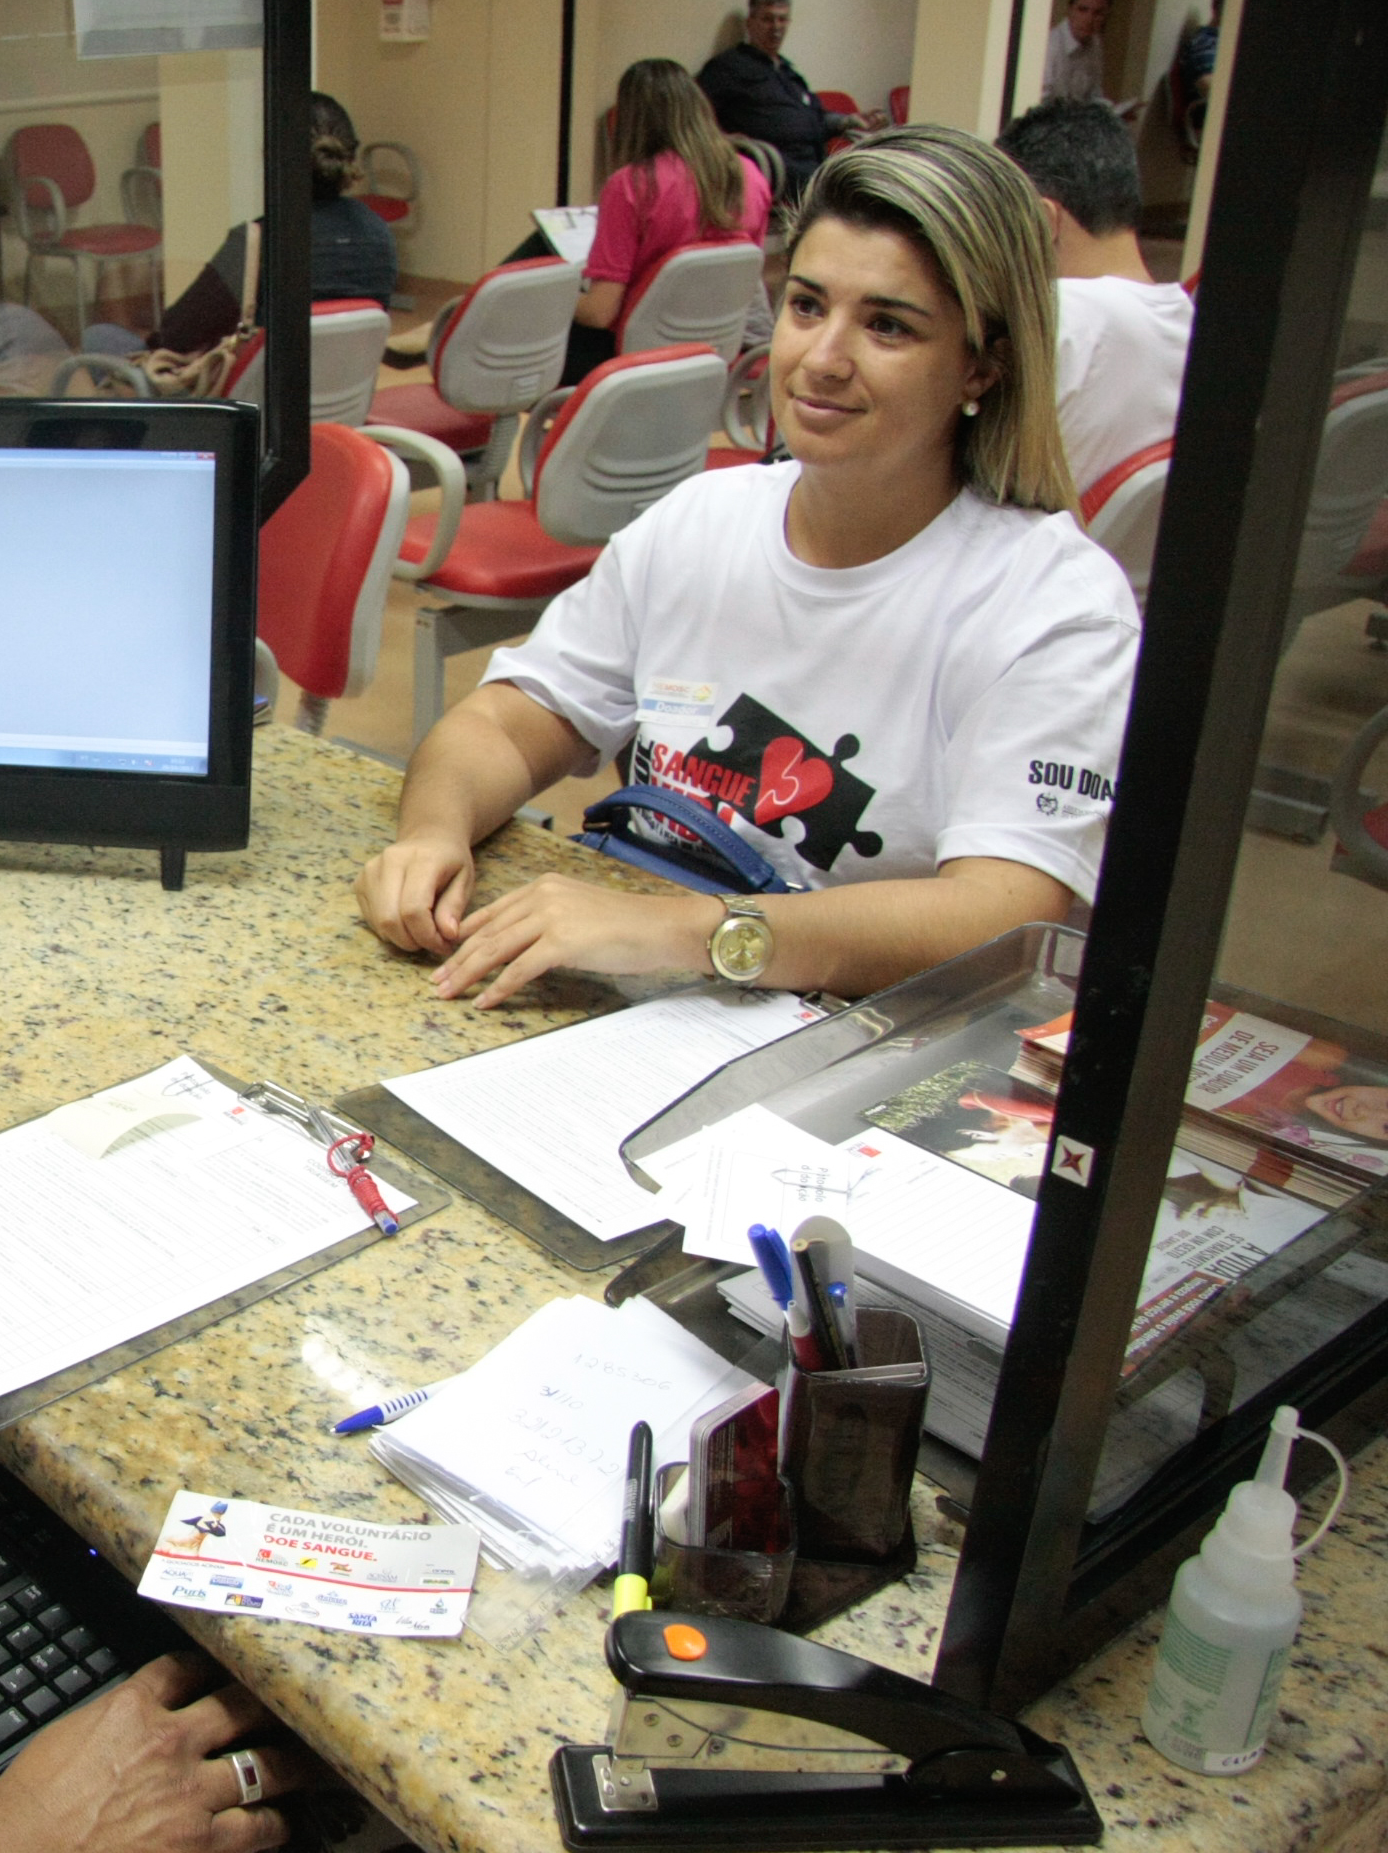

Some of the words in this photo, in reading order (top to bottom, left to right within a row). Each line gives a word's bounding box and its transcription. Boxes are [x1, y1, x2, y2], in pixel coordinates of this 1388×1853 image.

[655, 701, 699, 716] Doador
[650, 742, 759, 808] SANGUE
[1028, 760, 1074, 790] SOU
[1077, 768, 1116, 801] DOA
[1228, 1029, 1256, 1046] DE
[1195, 1041, 1243, 1077] MEDULA
[1244, 1041, 1280, 1062] SEJA
[1229, 1058, 1260, 1074] UM
[1196, 1070, 1244, 1095] DOADOR
[1191, 1233, 1207, 1246] UM
[1201, 1225, 1225, 1240] COM
[1225, 1233, 1245, 1245] SE
[1180, 1243, 1236, 1270] TRANSMITE
[1244, 1243, 1270, 1256] A
[1204, 1252, 1262, 1281] VIDA
[573, 1353, 672, 1391] 1285306
[266, 1523, 276, 1533] É
[279, 1526, 307, 1538] UM
[311, 1530, 368, 1549] HERÓI.
[270, 1513, 317, 1528] CADA
[321, 1521, 432, 1542] VOLUNTÁRIO
[263, 1534, 299, 1549] DOE
[302, 1541, 378, 1562] SANGUE.
[347, 1612, 378, 1622] SANTA
[351, 1618, 373, 1628] RITA
